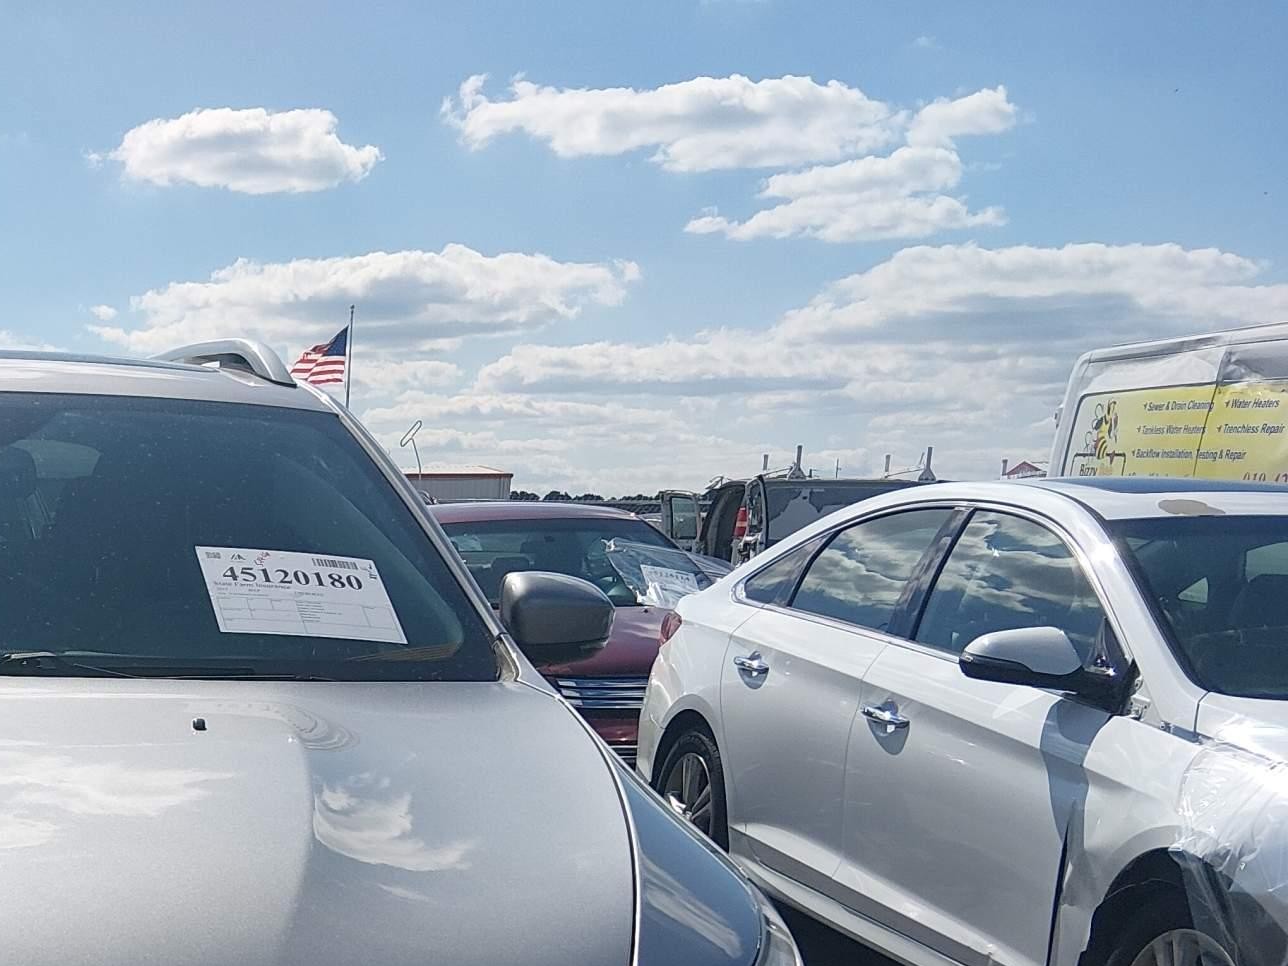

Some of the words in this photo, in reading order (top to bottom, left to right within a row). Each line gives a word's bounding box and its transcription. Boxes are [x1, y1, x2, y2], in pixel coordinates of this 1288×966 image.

[1147, 401, 1165, 411] Sewer
[1171, 400, 1187, 410] Drain
[1187, 399, 1214, 412] Cleaning
[1231, 399, 1251, 409] Water
[1252, 398, 1280, 409] Heaters
[1166, 425, 1182, 434] Water
[1223, 423, 1260, 434] Trenchless
[1260, 423, 1285, 436] Repair
[1136, 449, 1160, 459] Backflow
[1225, 449, 1247, 461] Repair
[223, 566, 362, 591] 45120180
